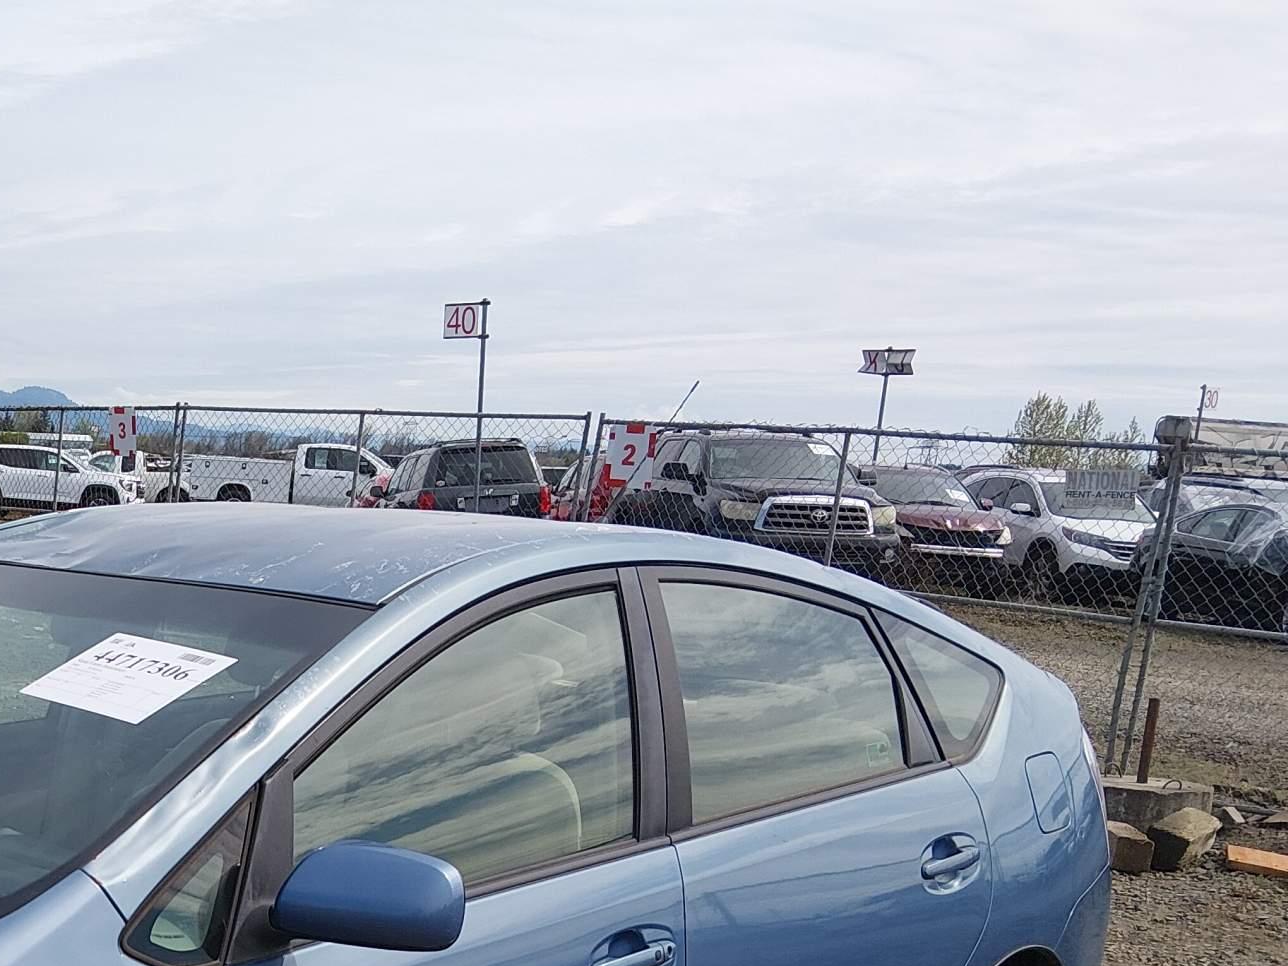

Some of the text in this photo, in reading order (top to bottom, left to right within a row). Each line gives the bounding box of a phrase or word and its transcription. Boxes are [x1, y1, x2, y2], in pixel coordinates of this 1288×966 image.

[446, 306, 476, 335] 40
[1205, 390, 1219, 409] 30
[118, 422, 126, 439] 3
[621, 444, 636, 466] 2
[1066, 471, 1138, 490] NATIONAL
[1065, 490, 1137, 499] RENT-A-FENCE
[93, 650, 198, 681] 44717306
